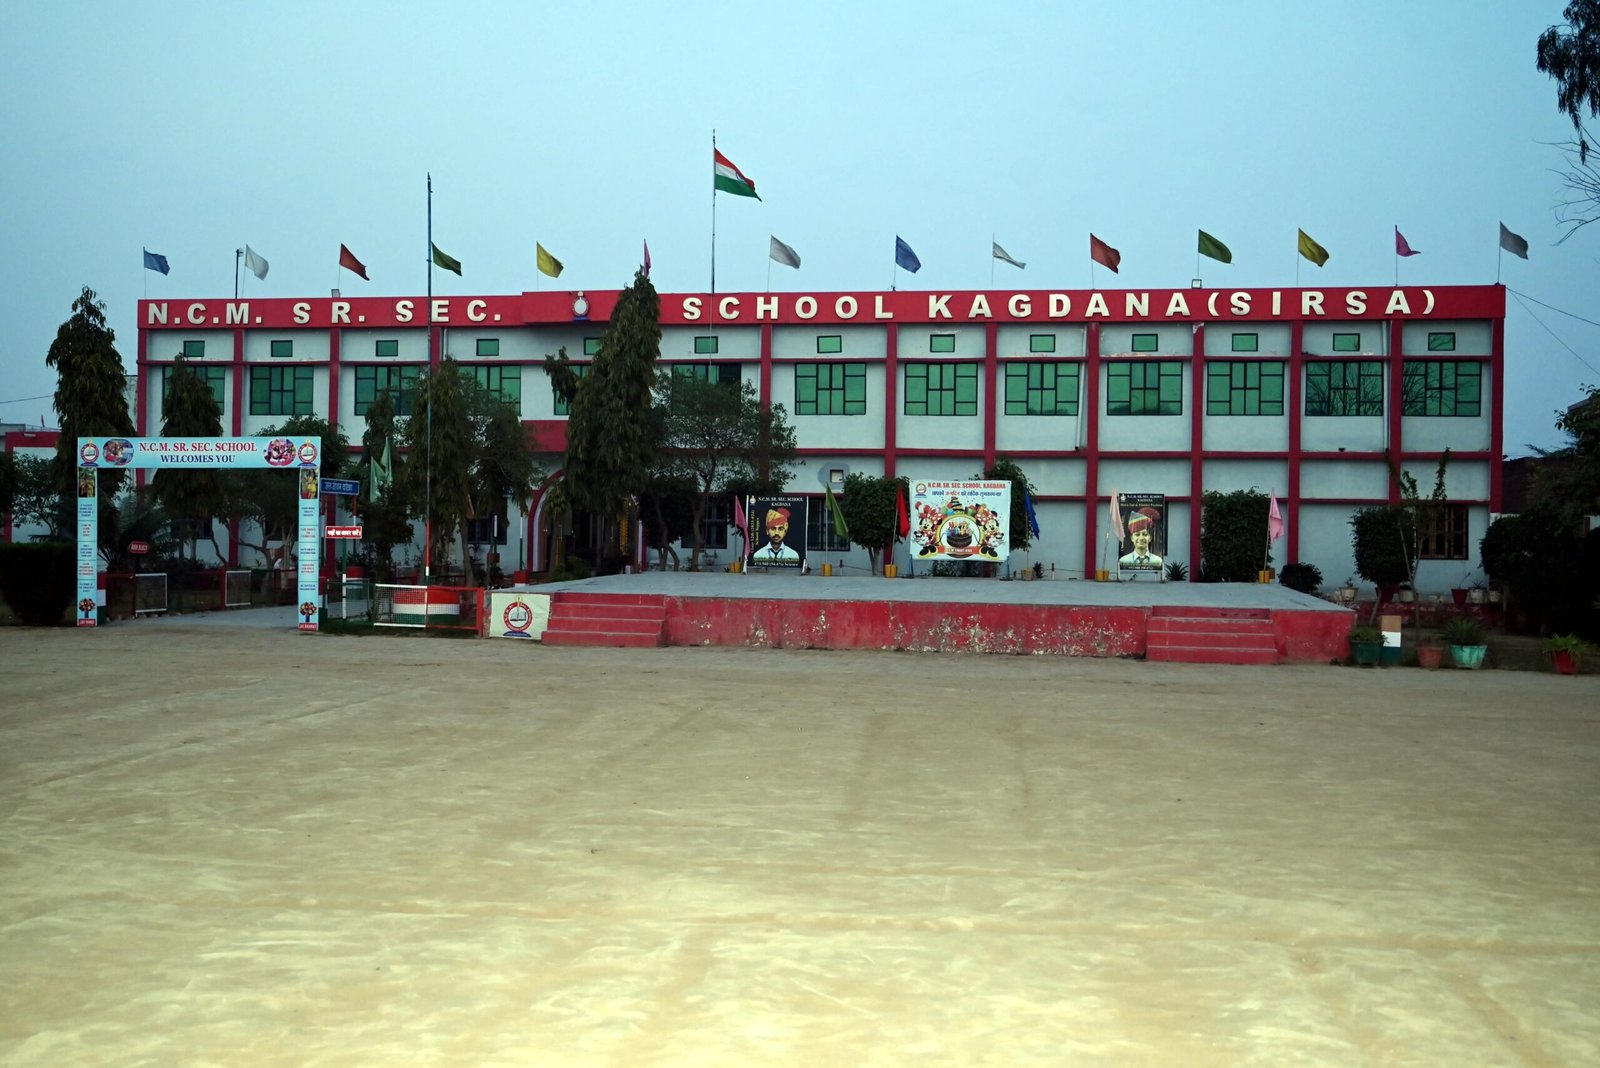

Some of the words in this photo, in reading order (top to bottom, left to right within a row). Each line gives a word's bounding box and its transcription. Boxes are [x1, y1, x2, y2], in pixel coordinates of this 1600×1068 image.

[147, 301, 263, 326] N.C.M.
[292, 299, 365, 324] SR.
[395, 297, 501, 323] SEC.
[682, 294, 894, 321] SCHOOL
[139, 442, 171, 452] N.C.M.
[173, 442, 189, 452] SR.
[191, 442, 213, 452] SEC.
[215, 442, 257, 452] SCHOOL
[160, 454, 214, 463] WELCOMES
[215, 454, 236, 463] YOU
